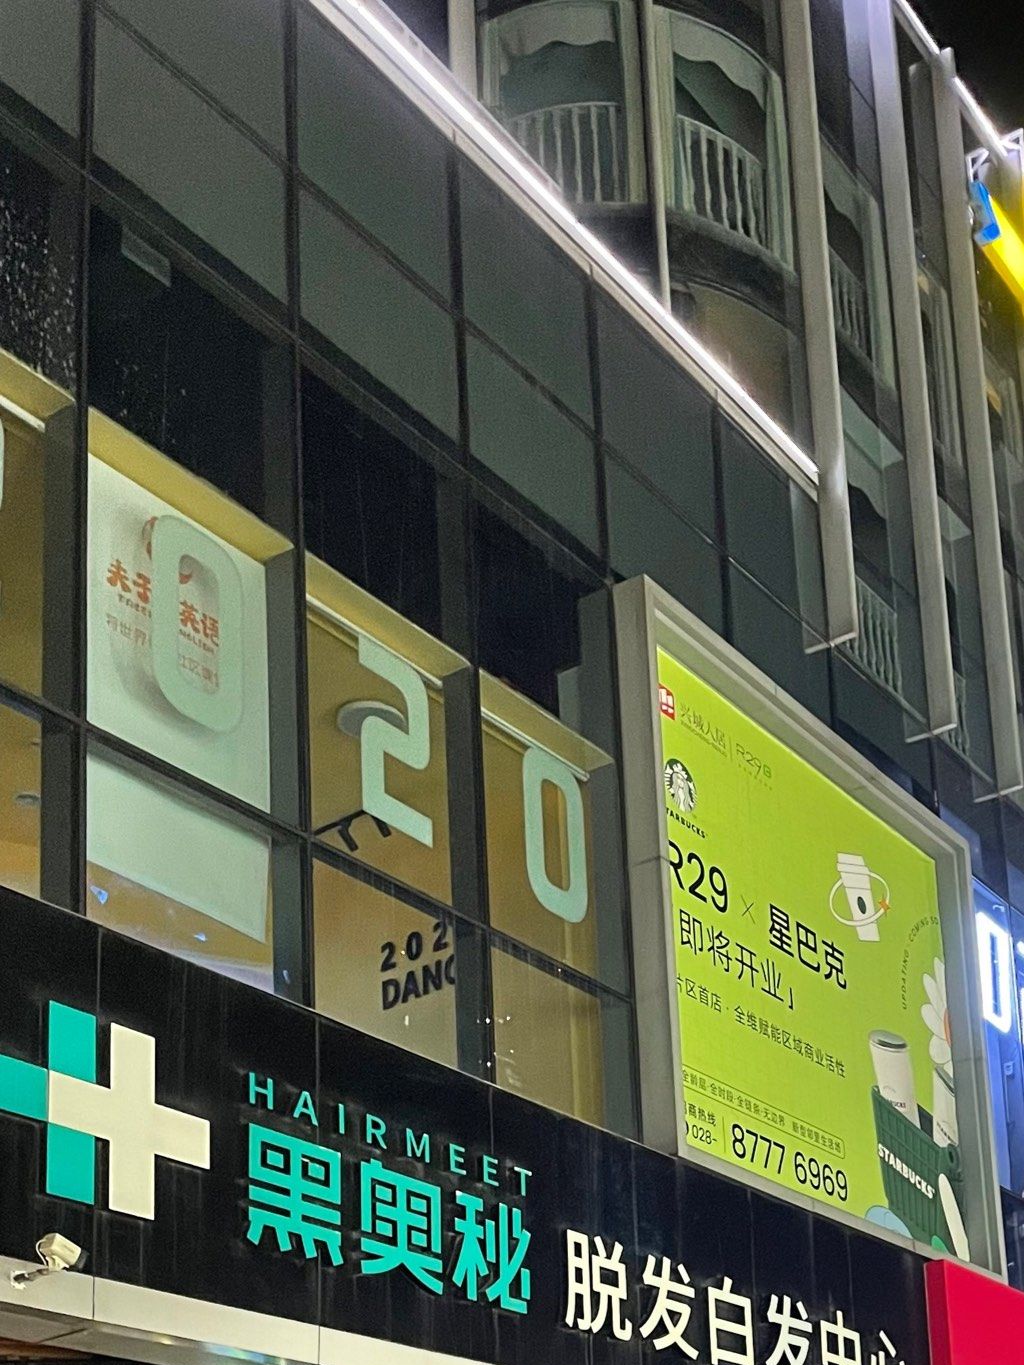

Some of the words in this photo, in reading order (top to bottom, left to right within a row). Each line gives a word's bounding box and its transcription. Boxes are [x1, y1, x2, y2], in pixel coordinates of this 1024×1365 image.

[666, 806, 706, 839] TARBUCKS
[669, 840, 728, 914] R29
[769, 903, 847, 989] 星巴克
[248, 1071, 536, 1198] HAIRMEET
[684, 1101, 717, 1128] 商热线
[731, 1122, 785, 1175] 8777
[794, 1151, 848, 1201] 6969
[878, 1143, 934, 1199] STARBUCKS
[246, 1122, 532, 1316] 黑奥秘
